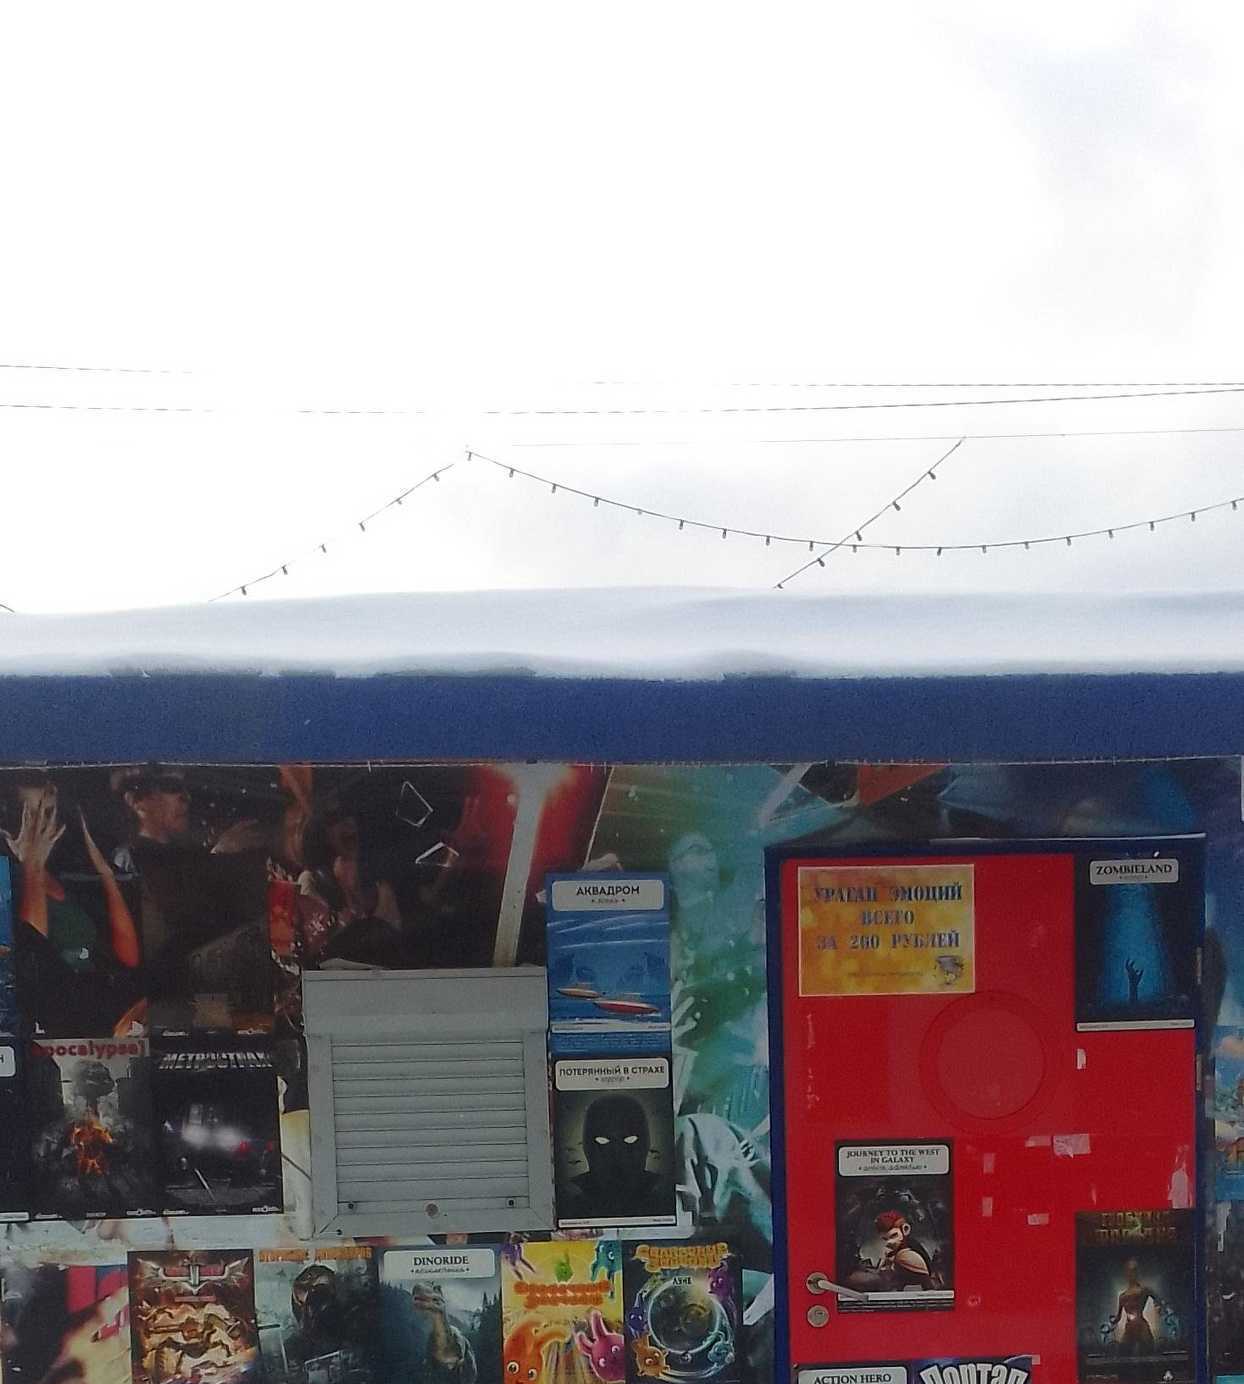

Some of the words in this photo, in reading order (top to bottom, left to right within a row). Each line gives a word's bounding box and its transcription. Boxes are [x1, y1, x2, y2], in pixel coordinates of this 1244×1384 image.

[1095, 863, 1173, 875] ZOMBIELAND
[576, 885, 641, 897] АКВАДРОМ
[815, 886, 877, 902] УРАГАН
[890, 882, 963, 904] ЭМОЦИЙ
[861, 909, 915, 926] ВСЕГО
[817, 934, 837, 950] ЗА
[892, 928, 960, 950] РУБЛЕЙ
[559, 1065, 621, 1077] ПОТЕРЯННЫЙ
[623, 1066, 630, 1075] В
[631, 1064, 665, 1075] СТРАХЕ
[847, 1149, 884, 1159] JOURNEY
[886, 1149, 899, 1157] TO
[900, 1148, 917, 1157] THE
[918, 1147, 941, 1157] WEST
[870, 1156, 880, 1164] IN
[881, 1155, 915, 1164] GALAXY
[413, 1255, 470, 1266] DINORIDE
[860, 1373, 892, 1384] HERO
